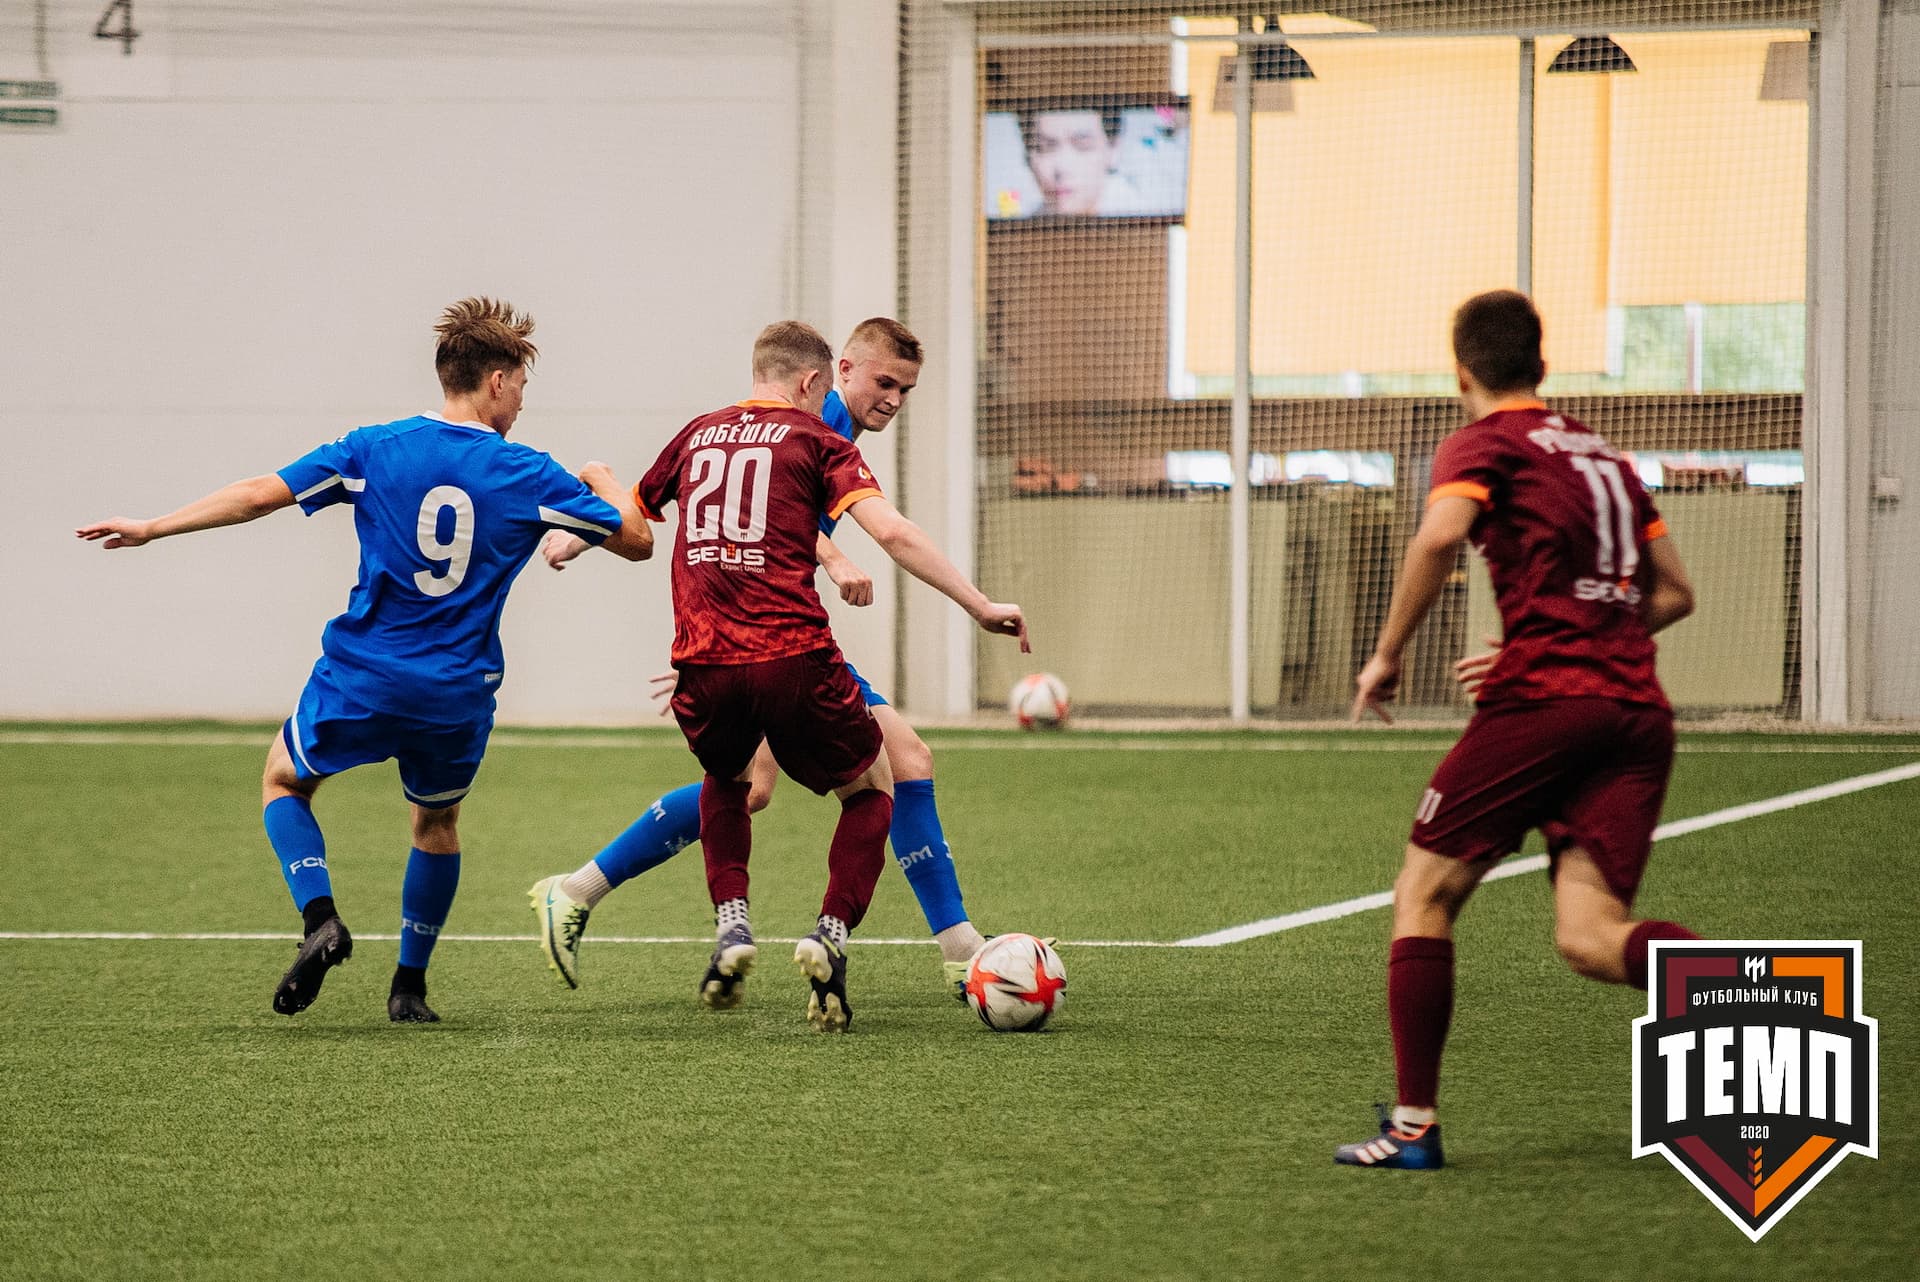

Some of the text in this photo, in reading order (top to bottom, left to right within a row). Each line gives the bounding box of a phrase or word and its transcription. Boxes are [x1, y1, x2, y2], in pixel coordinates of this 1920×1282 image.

[96, 0, 140, 55] 4
[689, 422, 792, 450] БОБЕШКО
[686, 447, 773, 543] 20
[1570, 456, 1640, 577] 11
[413, 485, 475, 597] 9
[687, 544, 765, 566] SEUS
